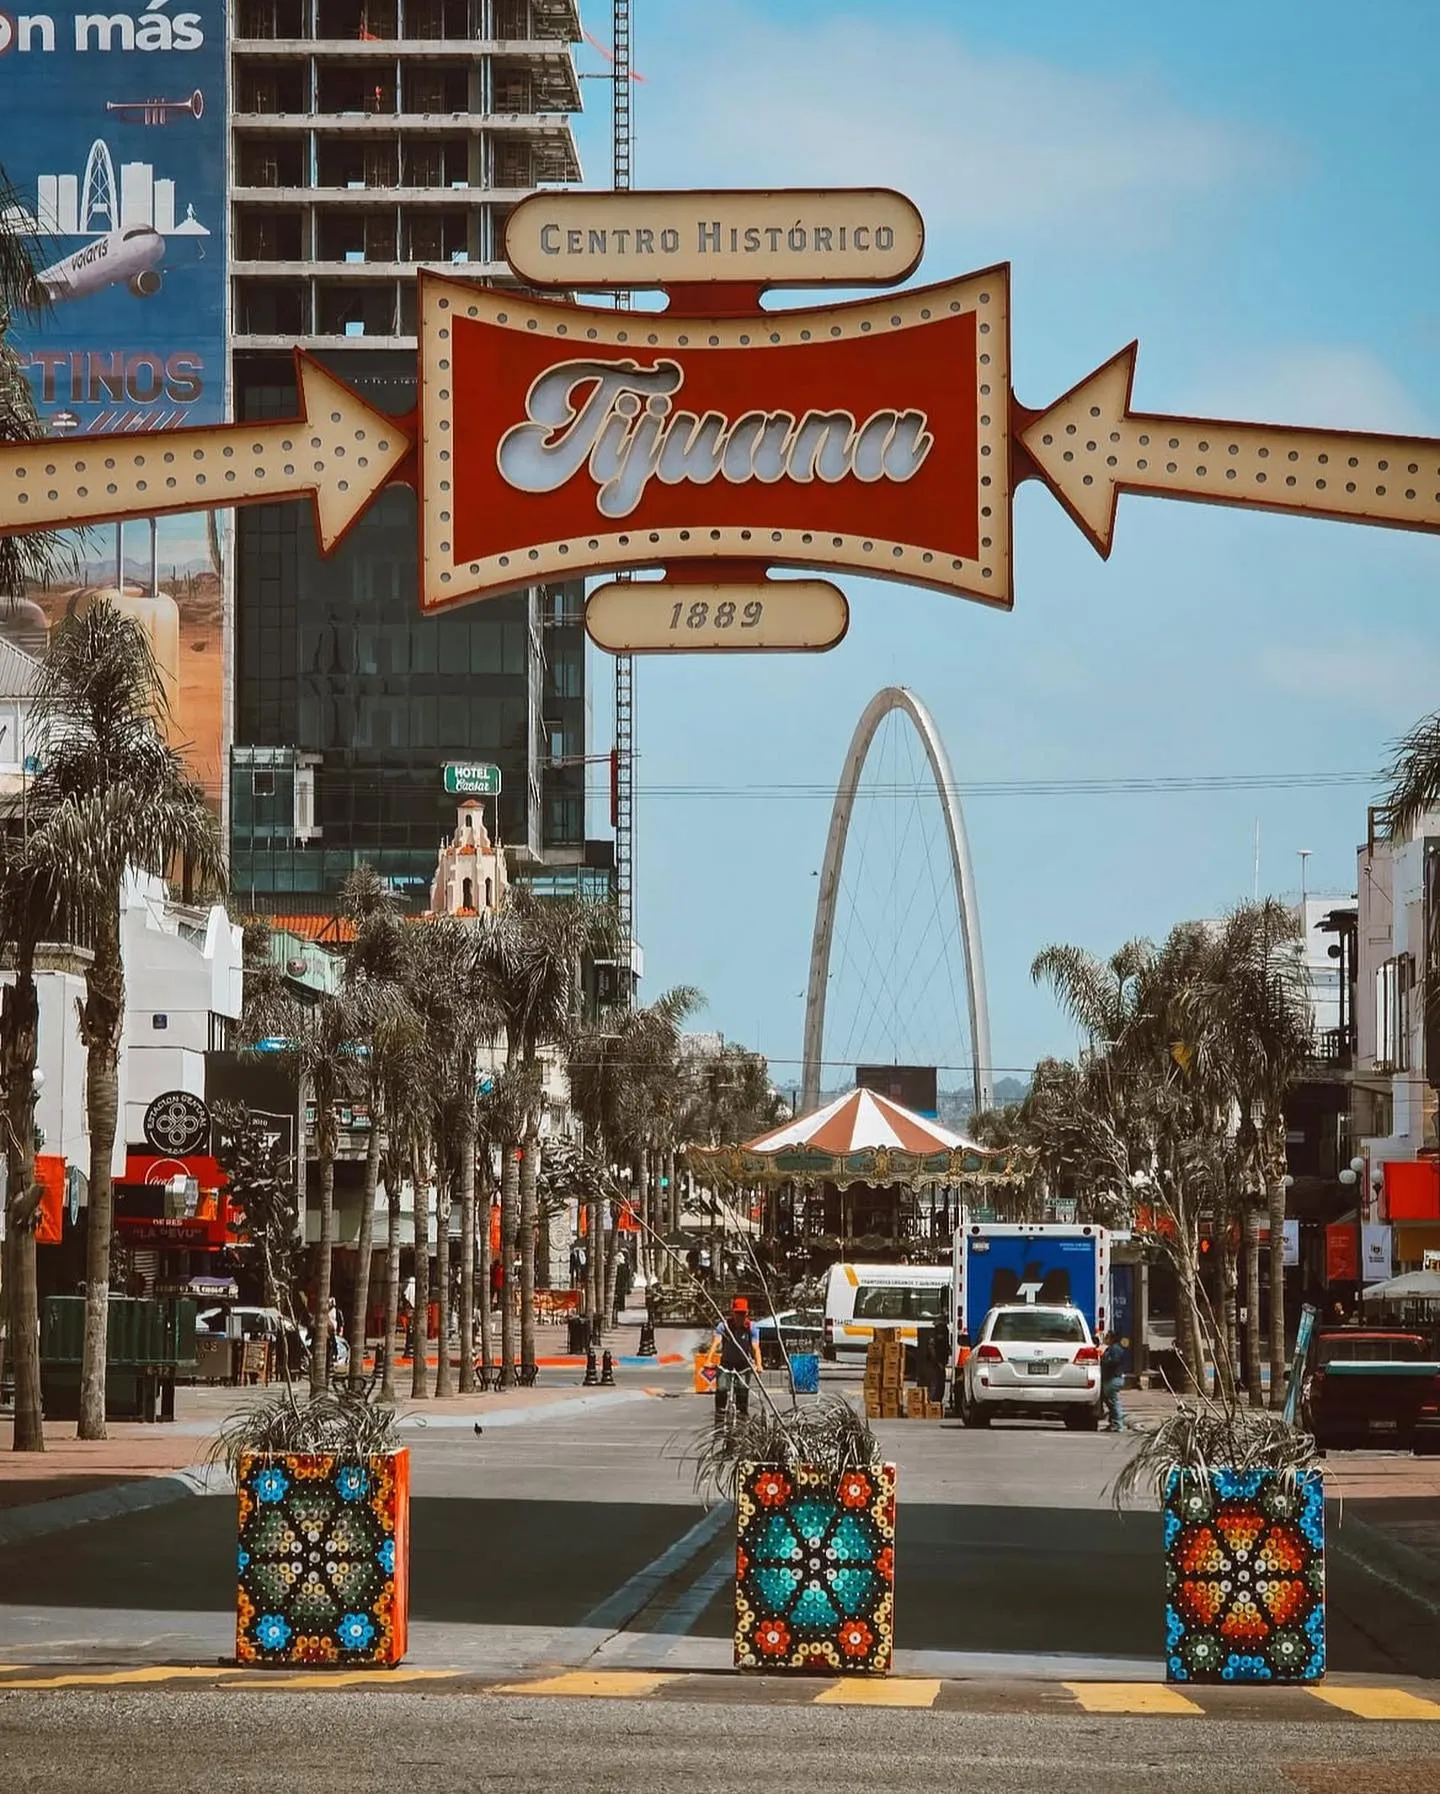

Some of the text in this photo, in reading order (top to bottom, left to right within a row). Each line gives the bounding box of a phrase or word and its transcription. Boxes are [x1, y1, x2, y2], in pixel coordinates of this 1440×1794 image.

[74, 0, 205, 51] más
[71, 238, 109, 272] volaris
[540, 220, 895, 255] CENTRO HISTÓRICO
[18, 351, 205, 404] TINOS
[496, 357, 934, 519] Tijuana
[669, 601, 763, 629] 1889
[454, 766, 490, 779] HOTEL
